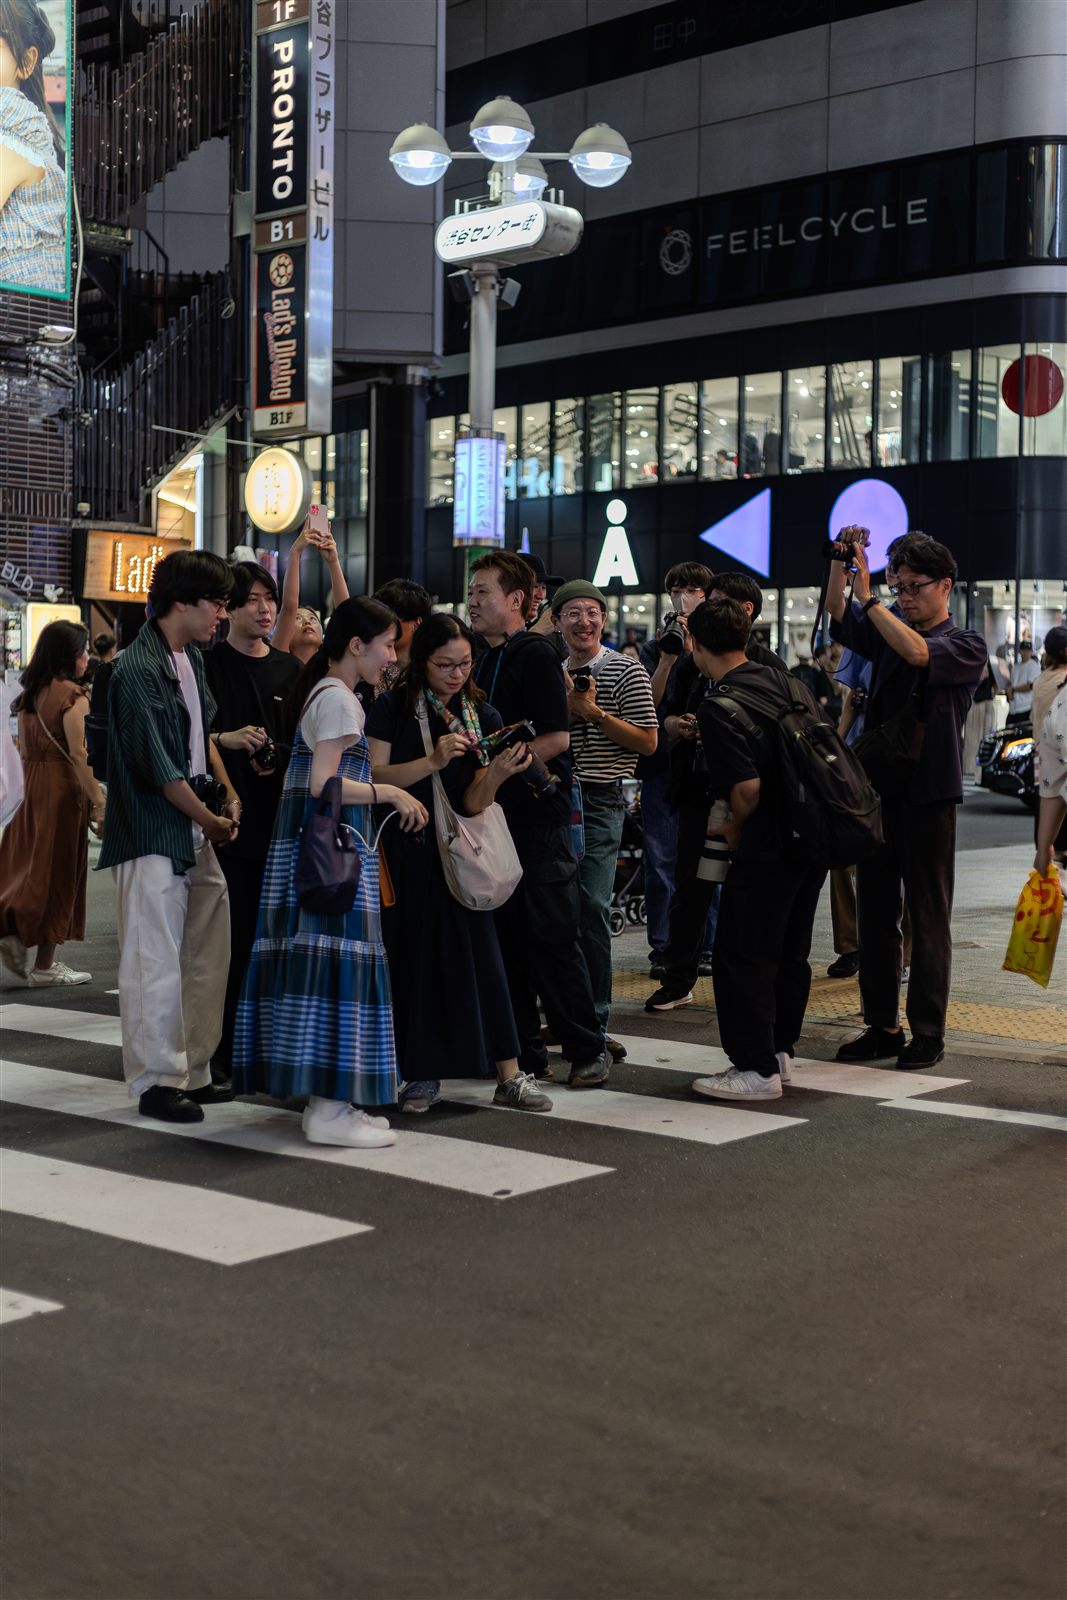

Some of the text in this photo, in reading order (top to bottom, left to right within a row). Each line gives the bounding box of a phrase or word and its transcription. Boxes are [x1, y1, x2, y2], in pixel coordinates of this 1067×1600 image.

[272, 0, 297, 23] 1F
[272, 38, 294, 200] PRONTO
[270, 220, 295, 243] B1
[707, 198, 929, 259] FEELCYCLE
[269, 411, 294, 426] B1F
